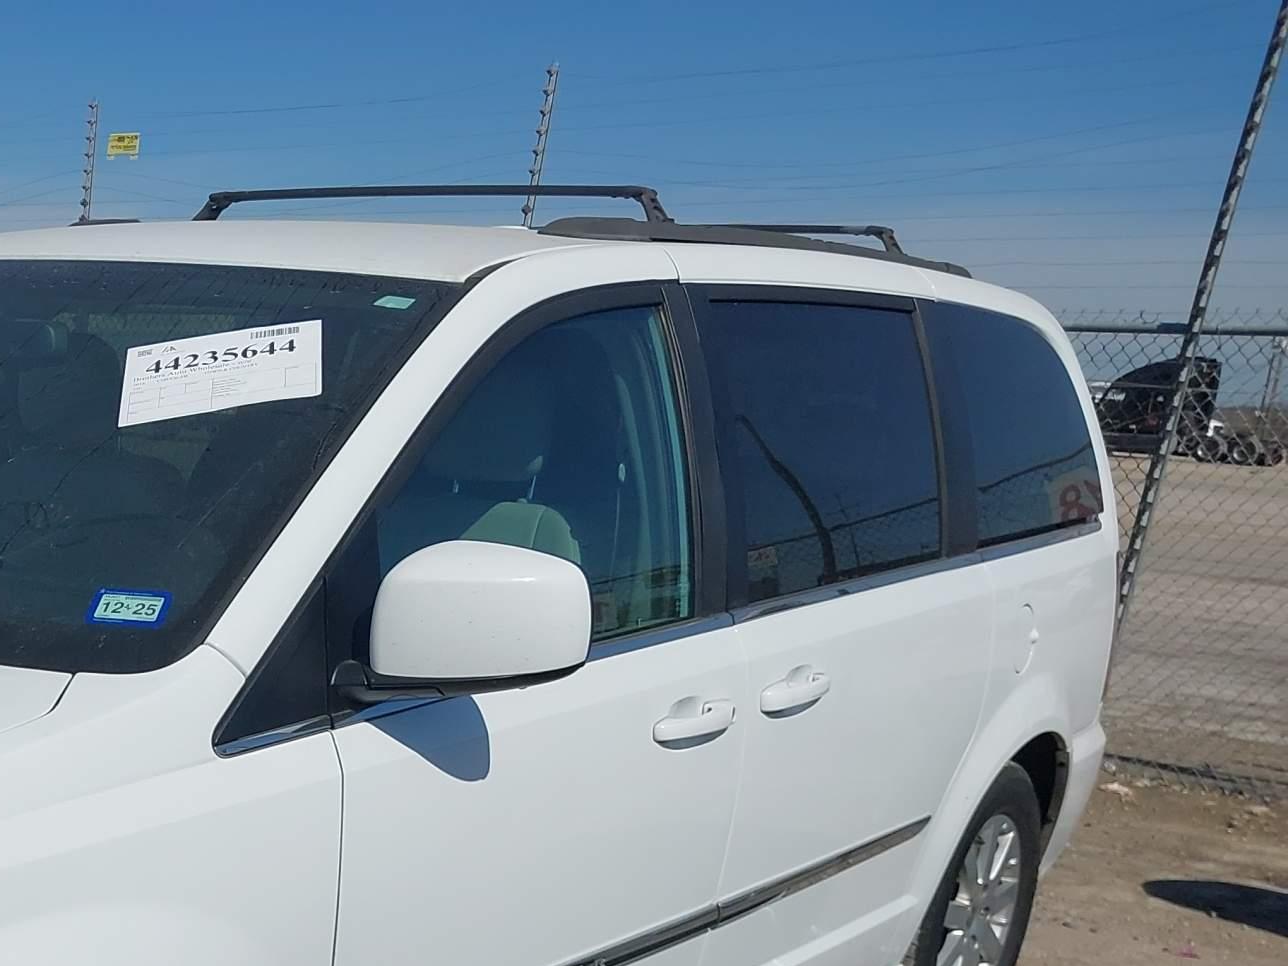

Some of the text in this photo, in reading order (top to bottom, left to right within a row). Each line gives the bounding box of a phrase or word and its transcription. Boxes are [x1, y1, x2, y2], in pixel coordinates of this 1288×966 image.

[146, 339, 297, 374] 44235644
[102, 601, 160, 616] 12 25
